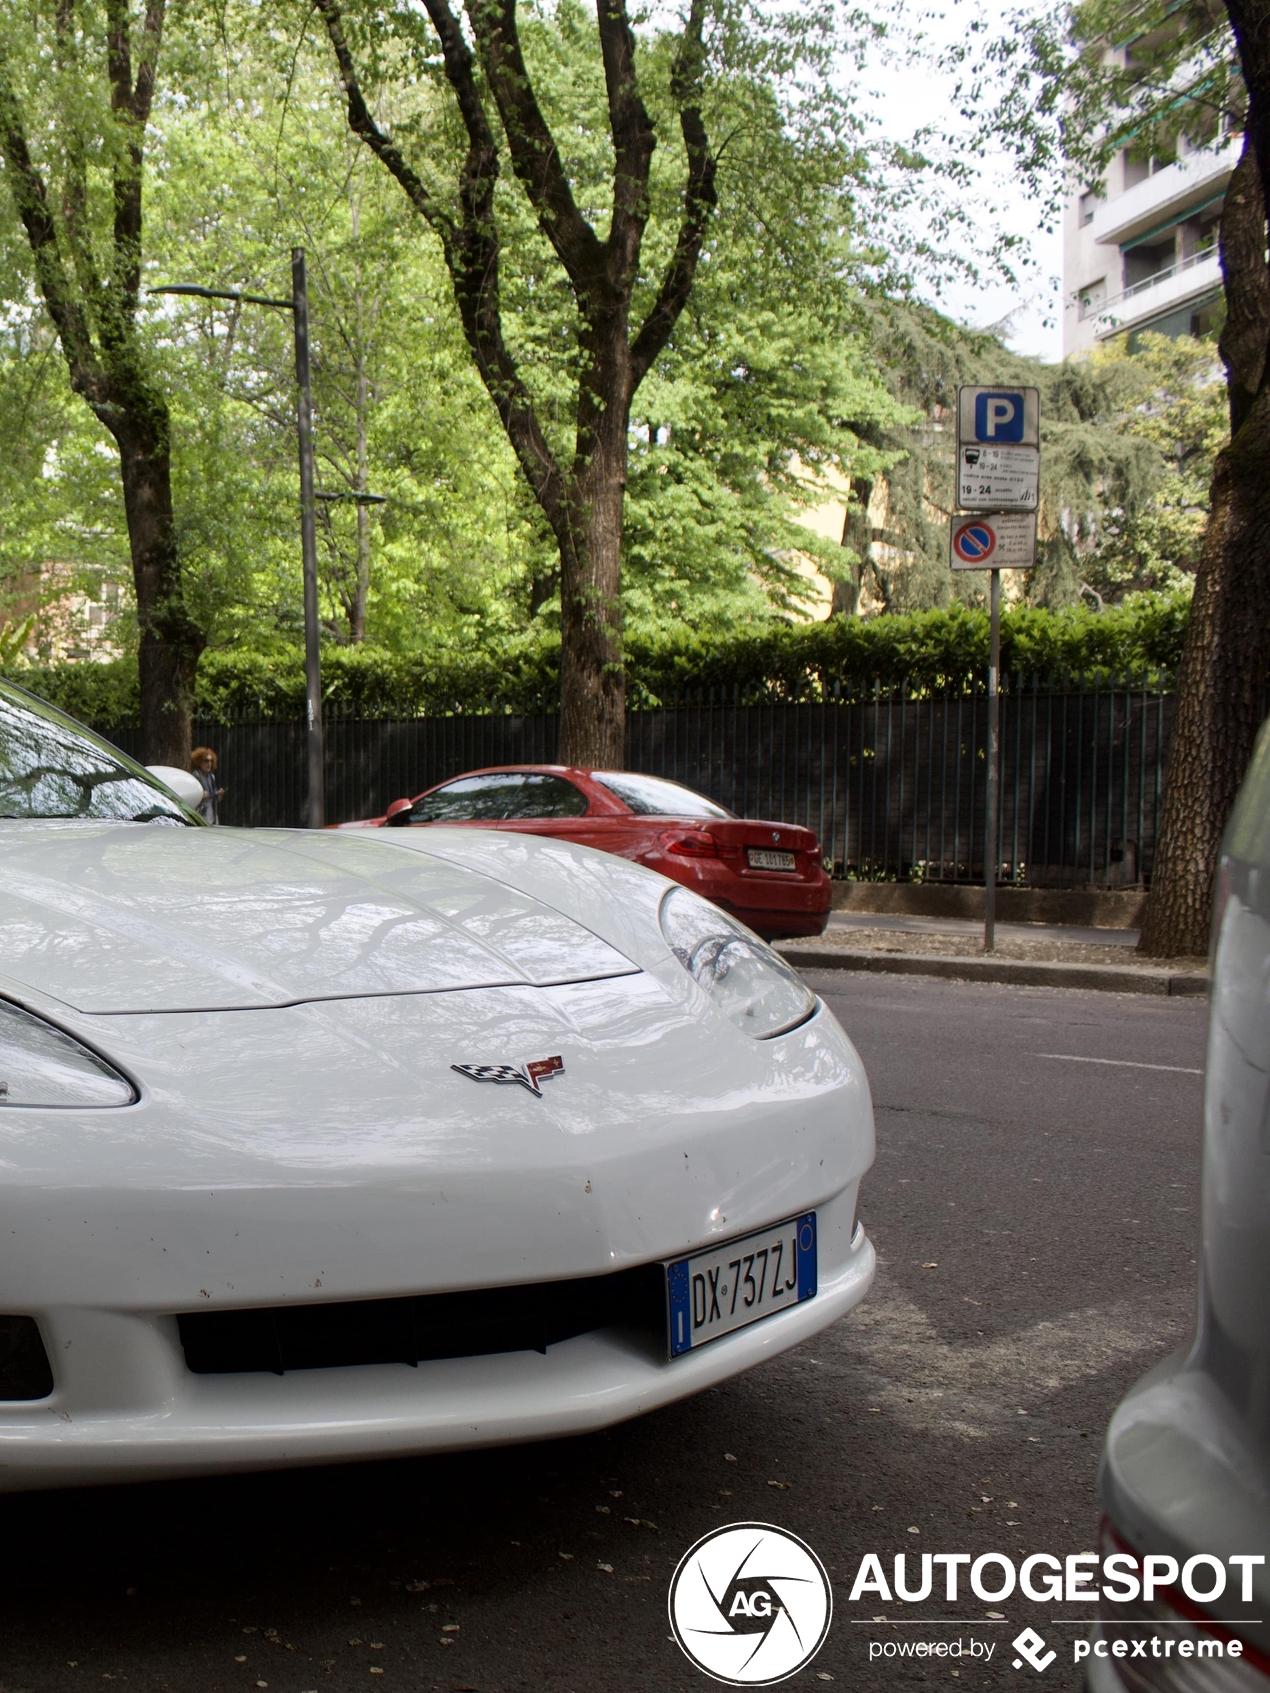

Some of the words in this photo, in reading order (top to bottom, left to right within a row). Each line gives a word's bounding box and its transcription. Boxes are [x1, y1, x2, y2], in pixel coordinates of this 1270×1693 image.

[987, 398, 1015, 437] P
[992, 450, 999, 458] 19
[979, 462, 985, 470] 19
[990, 463, 998, 471] 24
[962, 485, 972, 494] 19
[979, 485, 991, 495] 24
